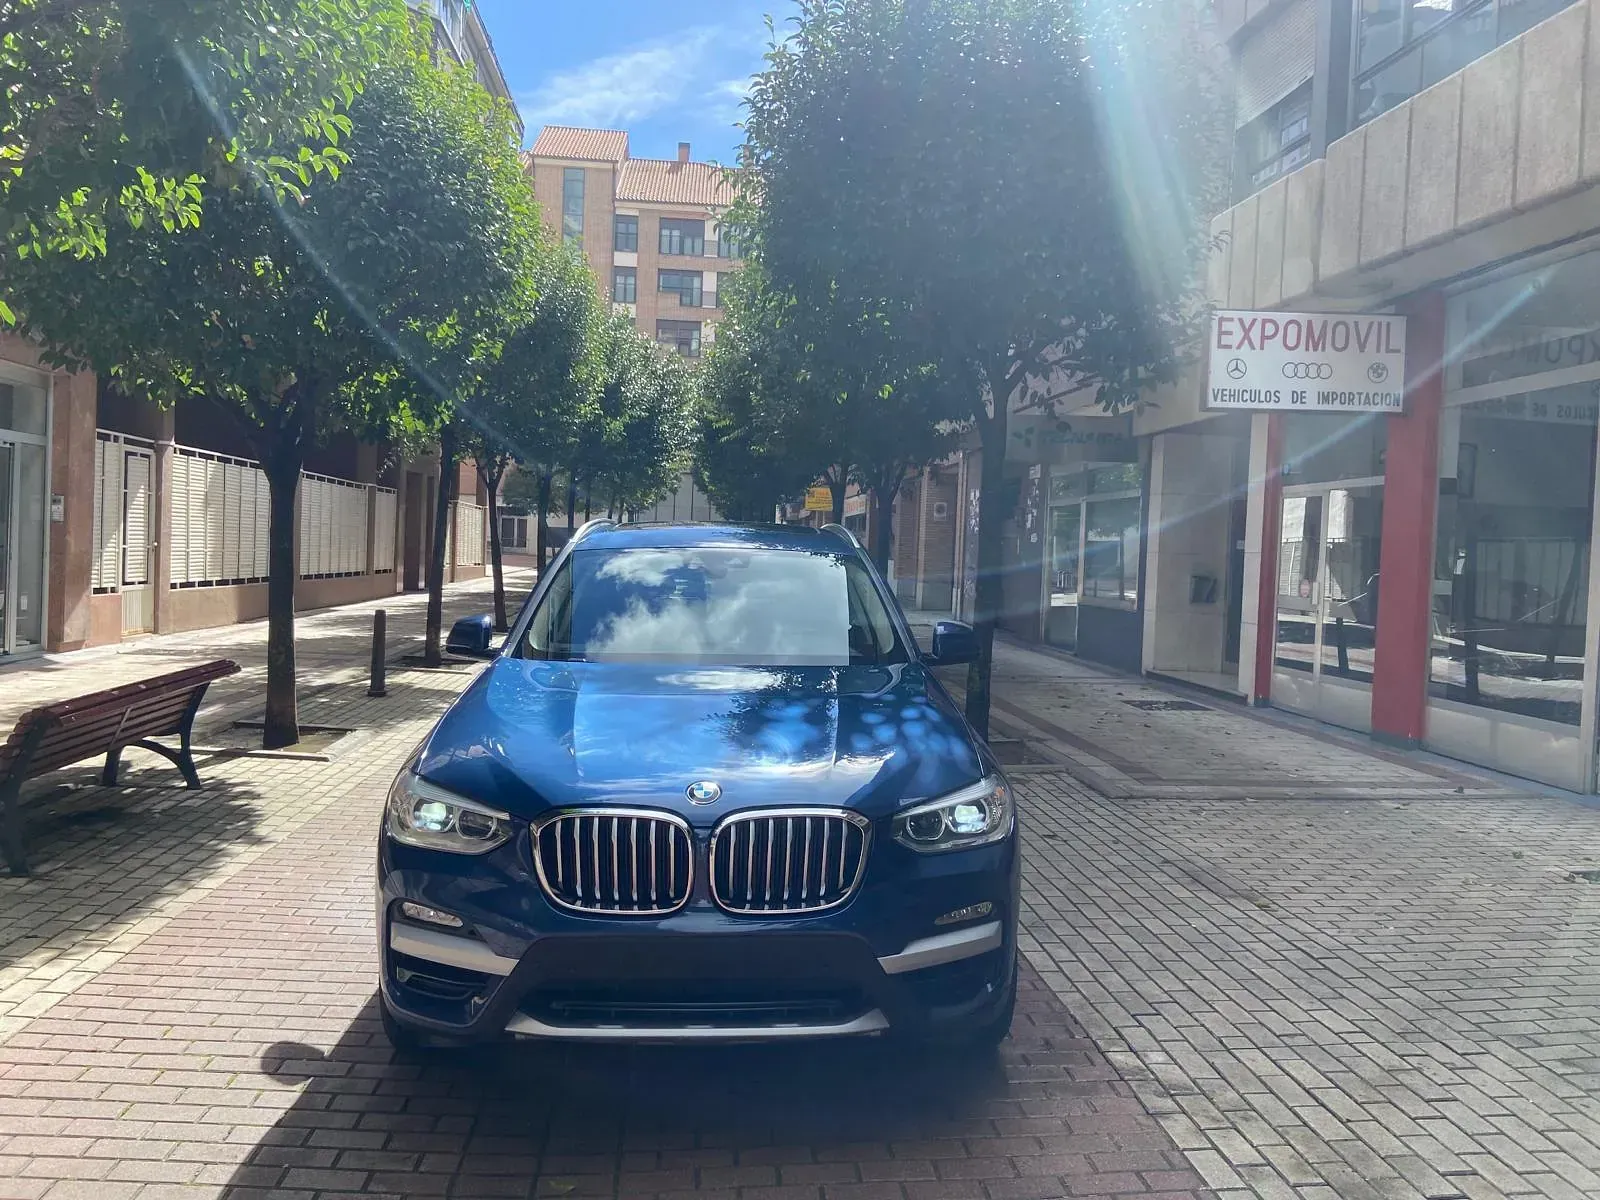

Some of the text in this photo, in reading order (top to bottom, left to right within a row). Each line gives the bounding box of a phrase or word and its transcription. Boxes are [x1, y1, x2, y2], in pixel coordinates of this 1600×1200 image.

[1216, 315, 1401, 354] EXPOMOVIL
[1212, 388, 1401, 407] VEHICULOS DE IMPORTACION
